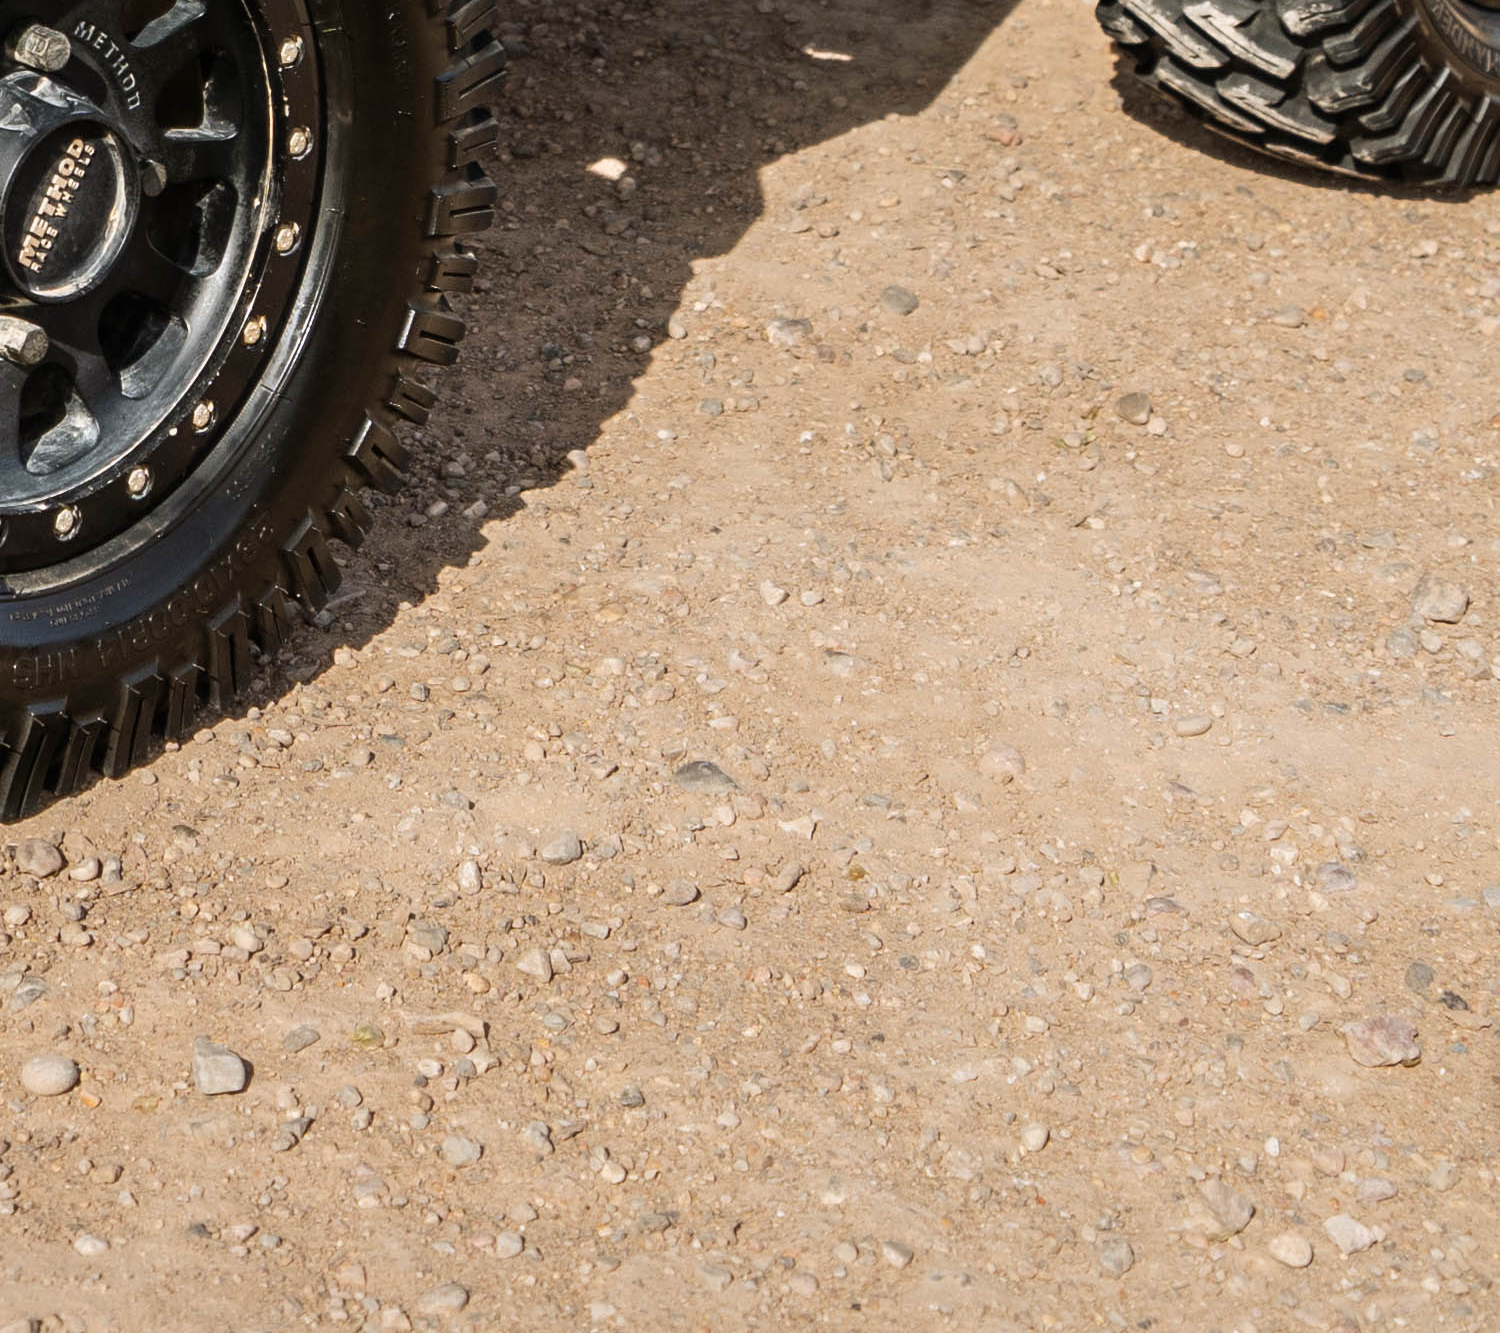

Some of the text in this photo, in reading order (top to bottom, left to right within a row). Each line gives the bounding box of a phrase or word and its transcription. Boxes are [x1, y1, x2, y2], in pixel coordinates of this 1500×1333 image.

[74, 21, 141, 110] METHOD
[18, 138, 84, 269] METHOD
[30, 143, 95, 274] RACE WHEELS
